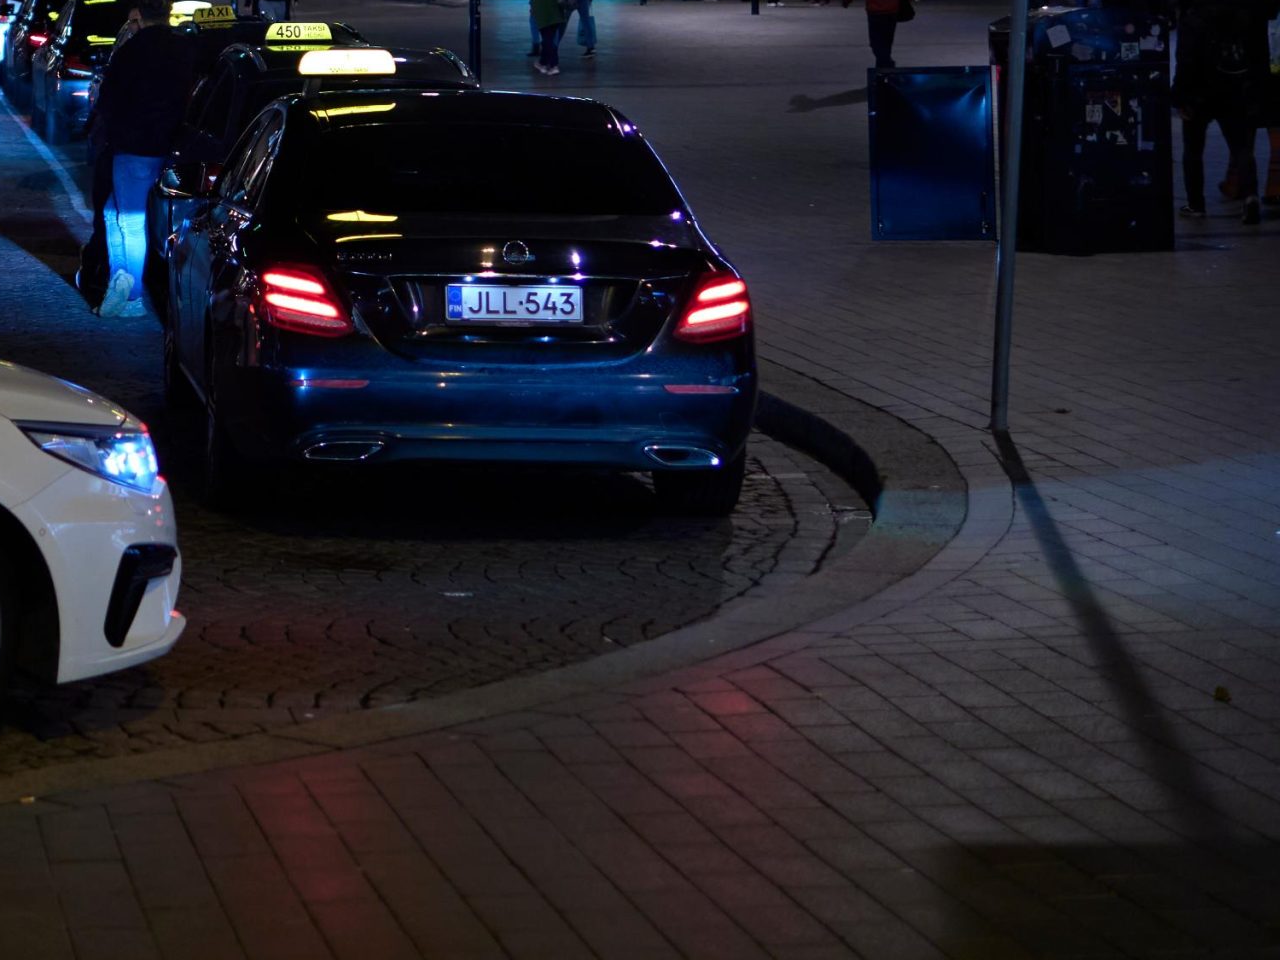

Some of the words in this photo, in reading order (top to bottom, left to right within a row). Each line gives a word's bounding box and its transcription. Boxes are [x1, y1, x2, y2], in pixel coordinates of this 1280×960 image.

[199, 7, 229, 18] TAXI
[276, 25, 302, 39] 450
[449, 305, 462, 313] FIN
